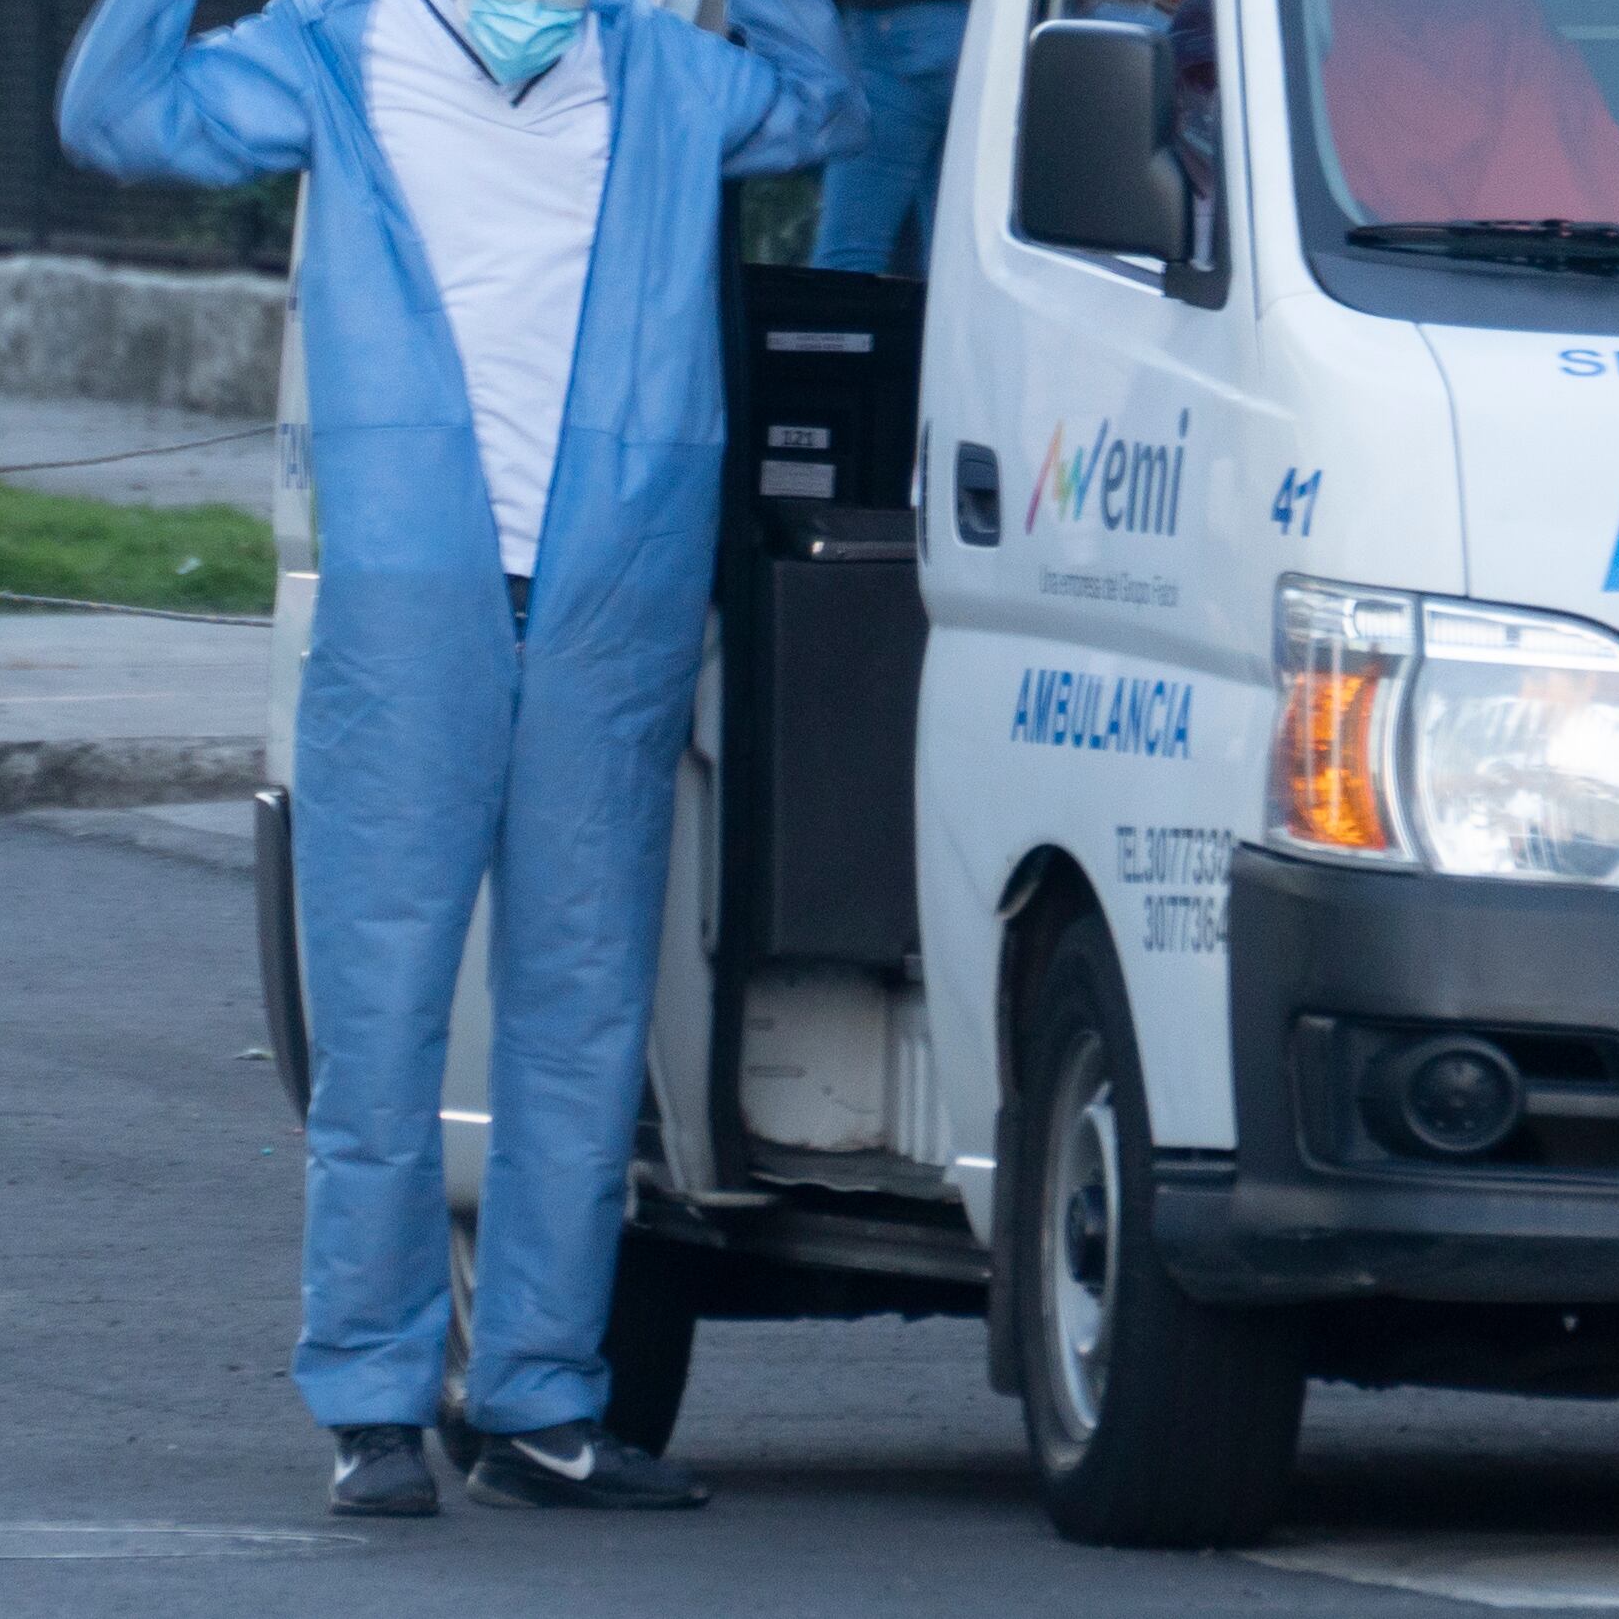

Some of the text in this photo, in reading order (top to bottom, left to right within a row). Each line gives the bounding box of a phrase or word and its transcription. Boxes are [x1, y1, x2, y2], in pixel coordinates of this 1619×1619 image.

[1099, 407, 1189, 536] emi
[1271, 467, 1322, 536] 41
[1010, 668, 1192, 760] AMBULANCIA
